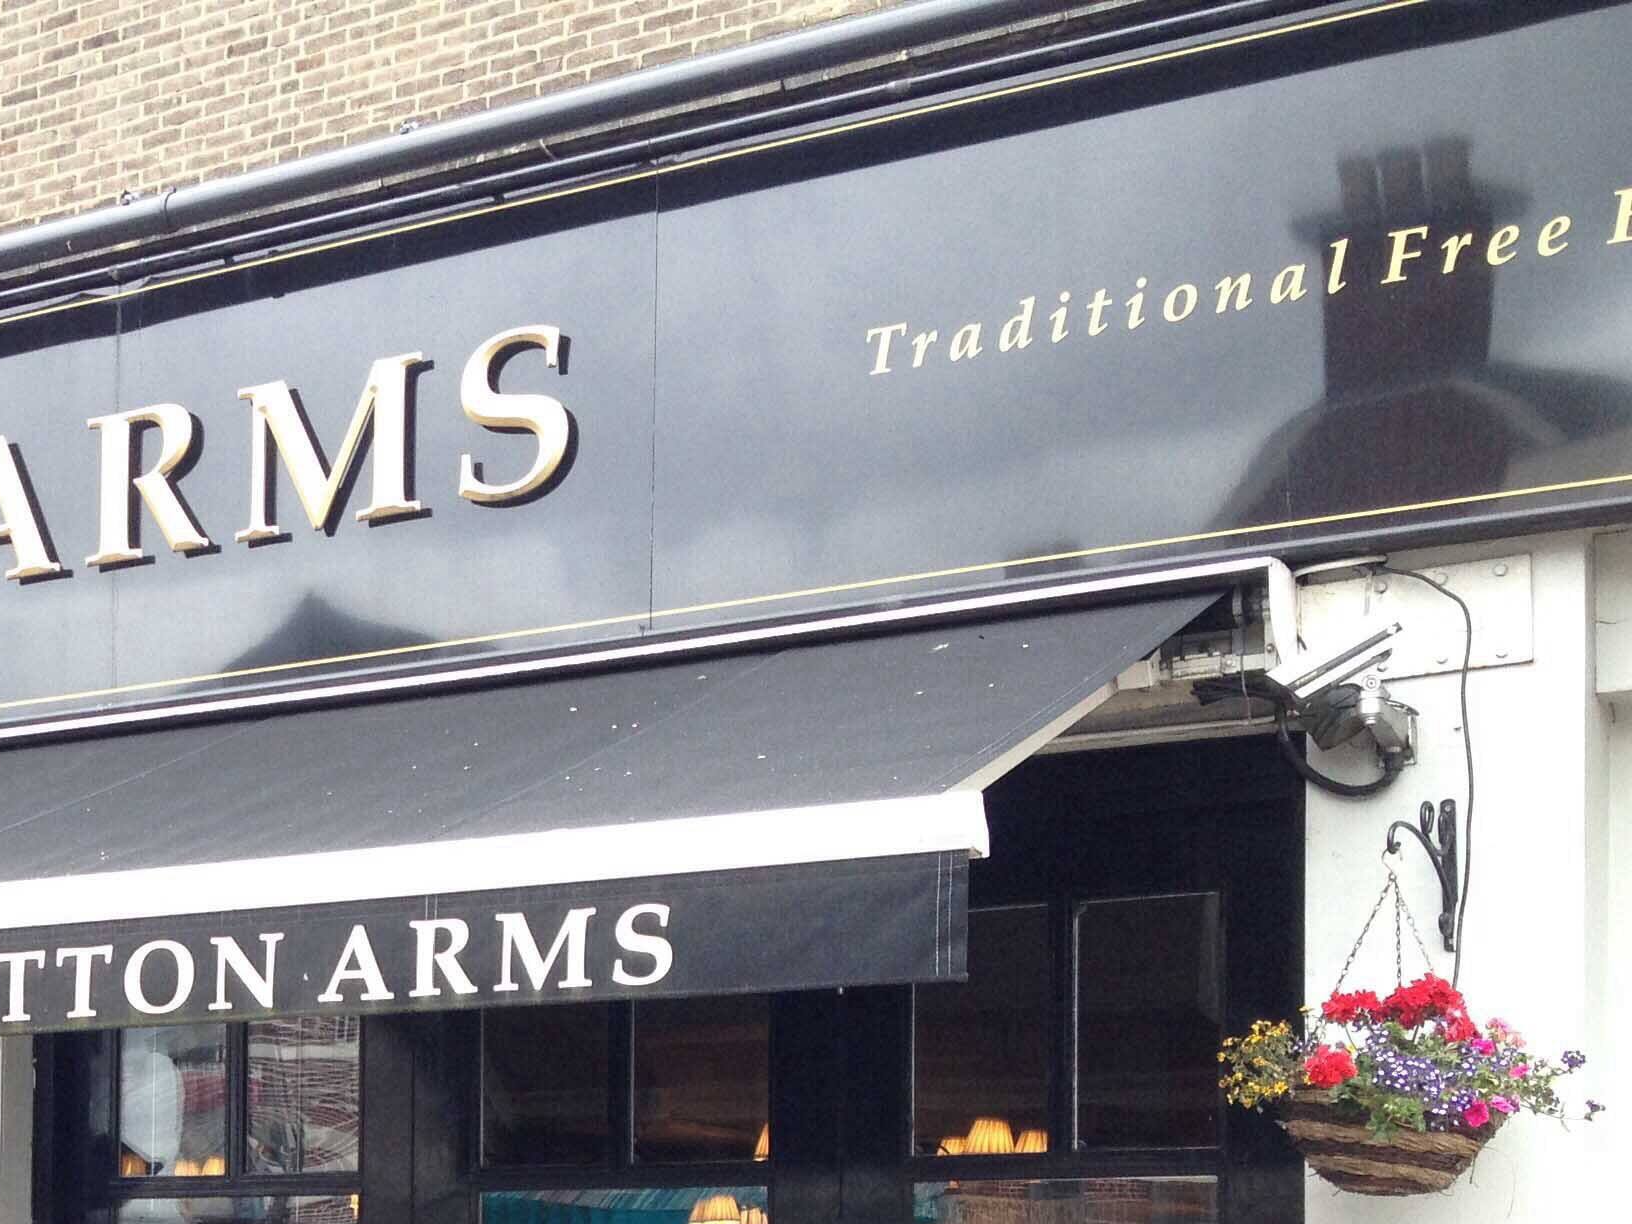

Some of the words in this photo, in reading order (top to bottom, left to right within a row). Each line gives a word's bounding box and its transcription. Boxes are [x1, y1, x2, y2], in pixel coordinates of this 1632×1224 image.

[866, 238, 1352, 377] Traditional
[1380, 215, 1572, 285] Free
[318, 903, 674, 1003] ARMS
